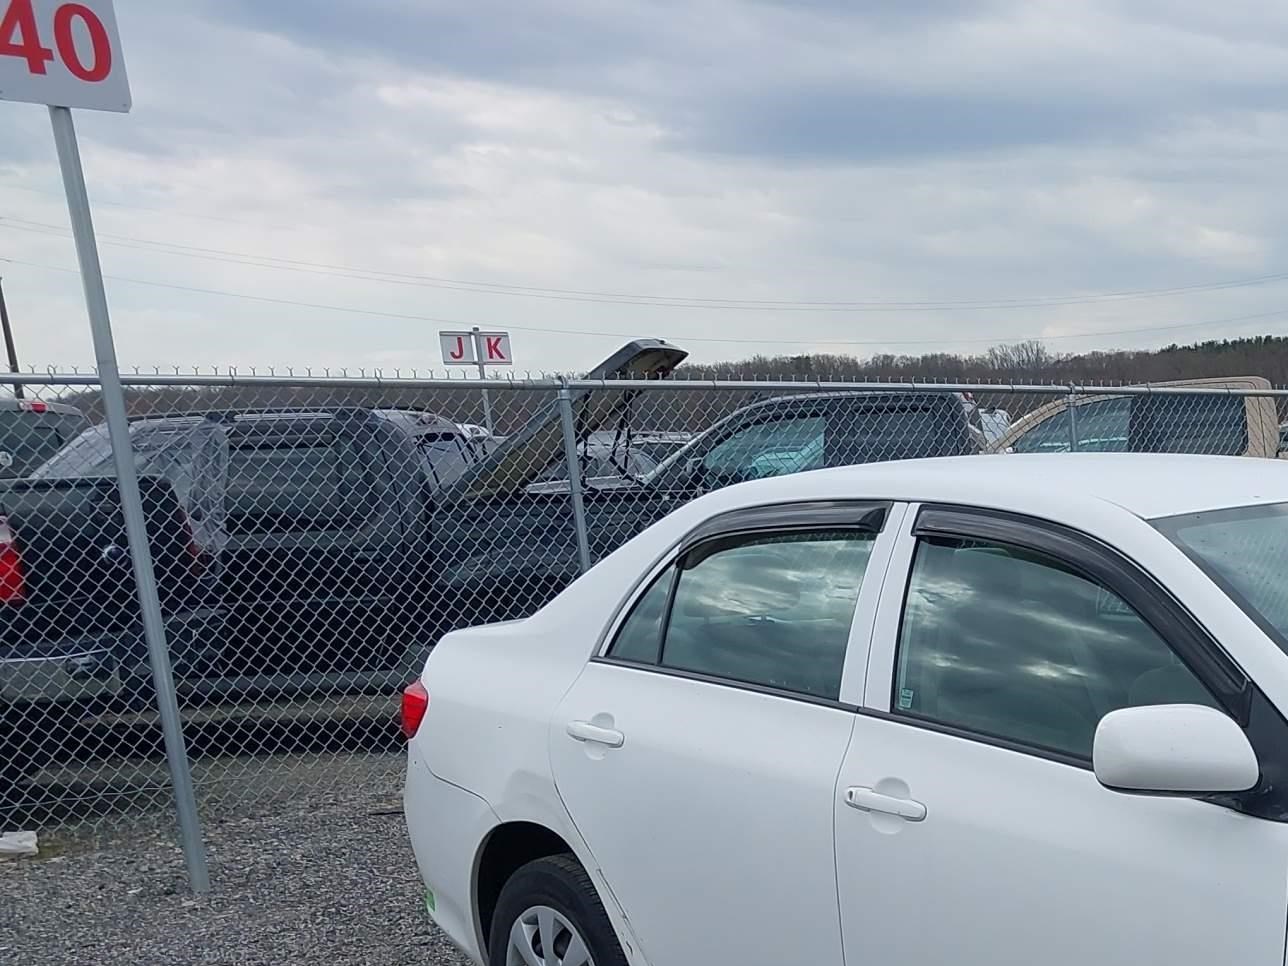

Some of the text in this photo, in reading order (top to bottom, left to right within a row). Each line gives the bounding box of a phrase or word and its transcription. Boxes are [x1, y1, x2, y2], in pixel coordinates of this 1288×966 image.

[0, 0, 112, 82] 40
[450, 336, 464, 359] J
[486, 337, 505, 359] K
